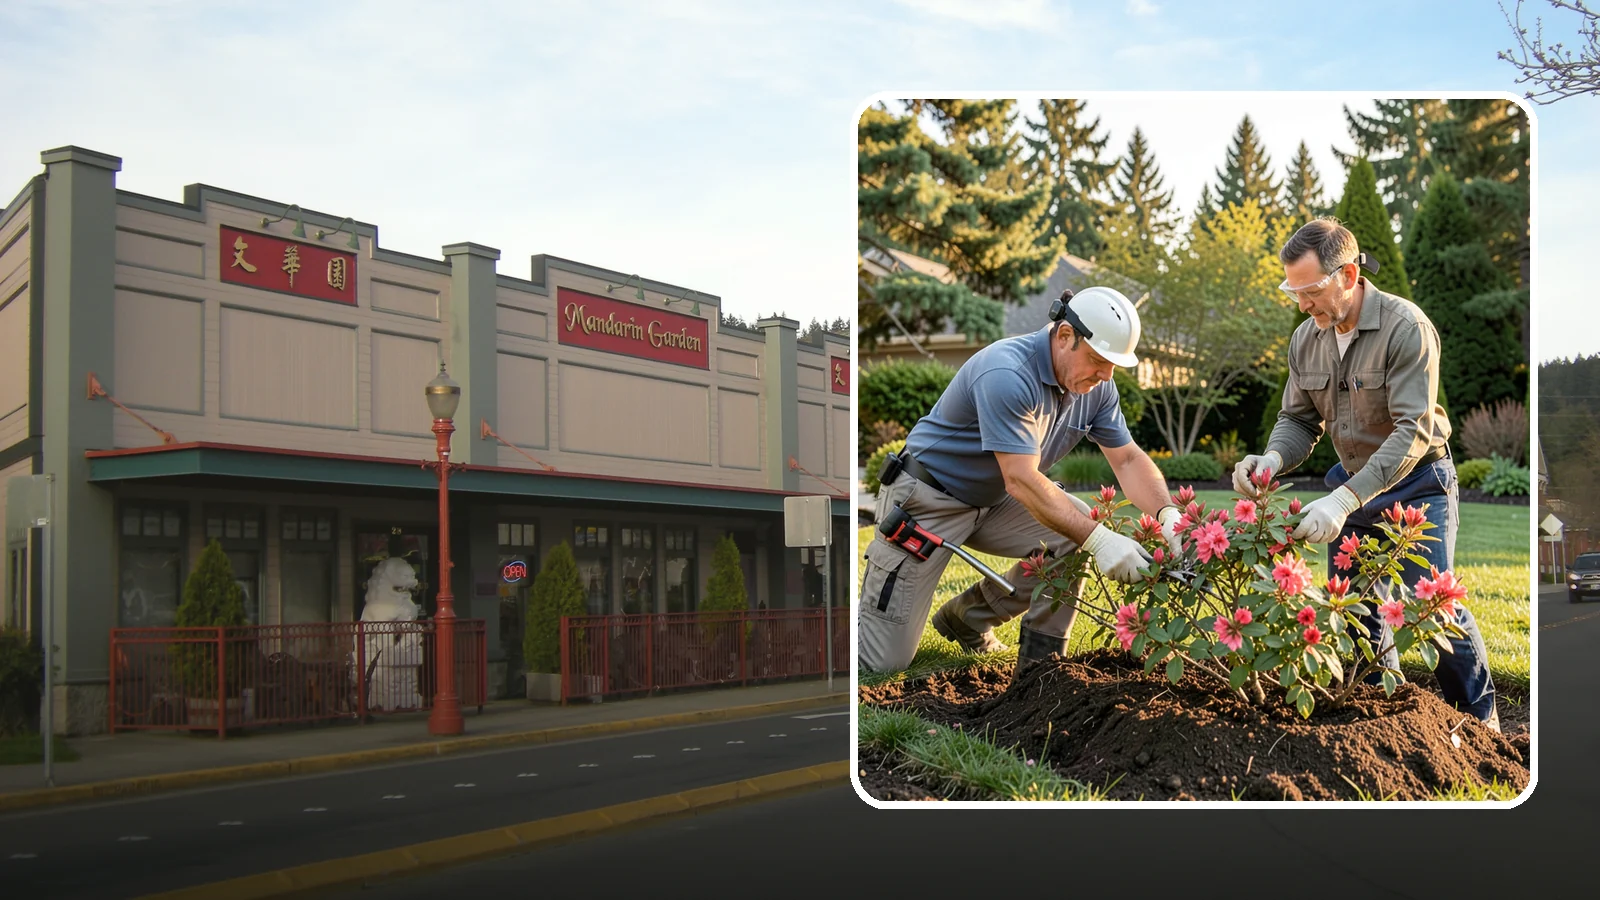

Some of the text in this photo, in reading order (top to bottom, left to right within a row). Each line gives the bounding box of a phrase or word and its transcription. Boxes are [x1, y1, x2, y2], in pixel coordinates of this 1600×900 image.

[230, 235, 346, 291] 文華園
[564, 302, 702, 352] Mandarin Garden
[503, 565, 527, 578] OPEN
